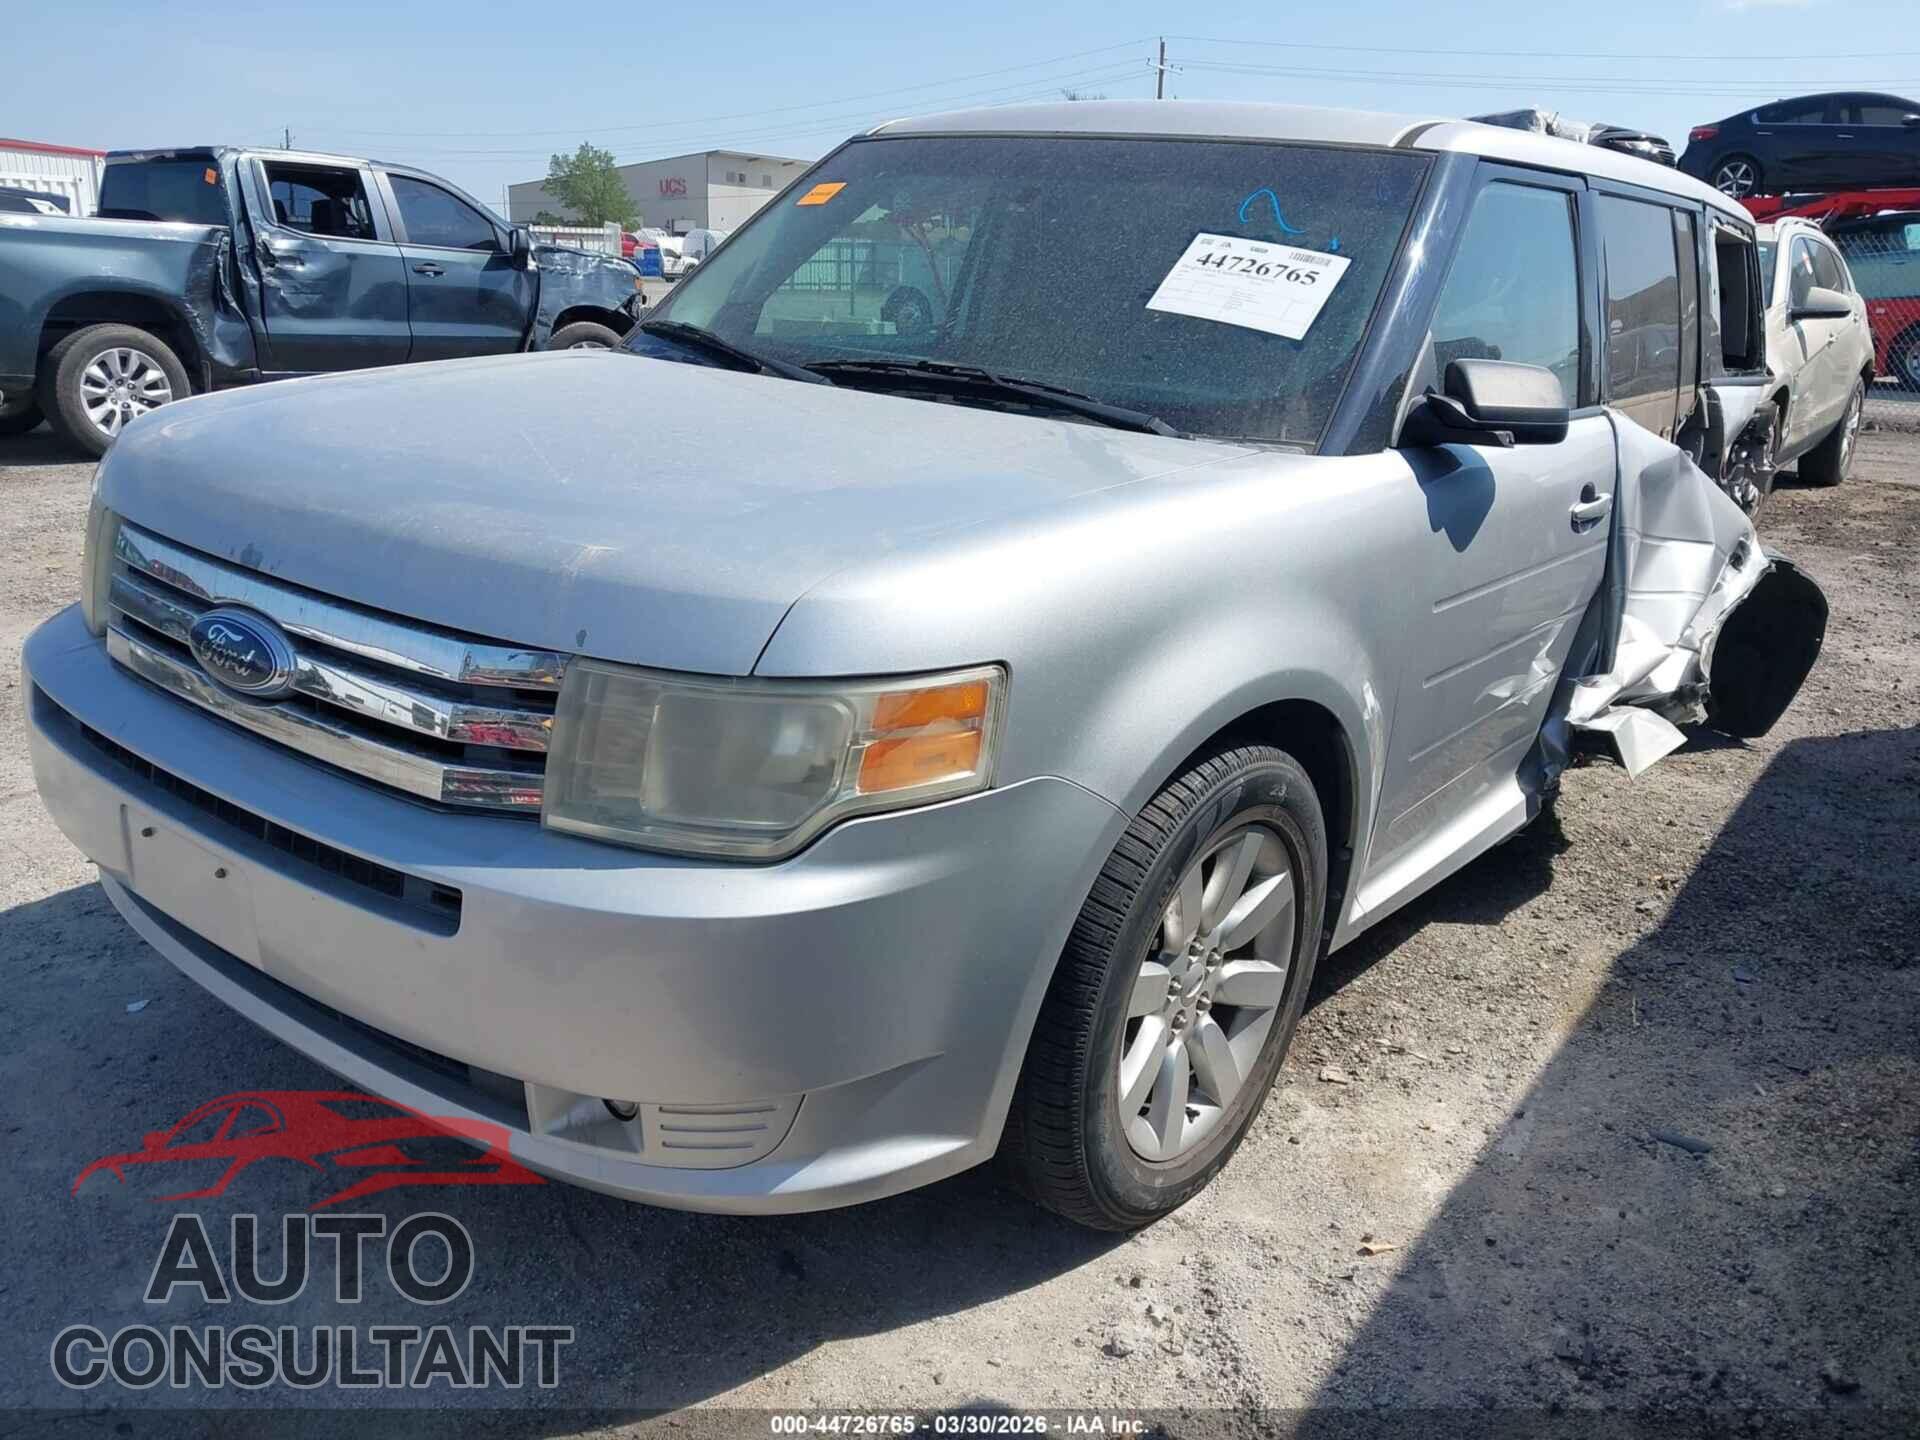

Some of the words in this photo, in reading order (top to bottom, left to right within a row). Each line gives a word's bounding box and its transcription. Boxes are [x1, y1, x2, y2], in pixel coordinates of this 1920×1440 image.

[659, 177, 687, 194] UCS
[1196, 252, 1320, 285] 44726765
[202, 624, 256, 677] Ford
